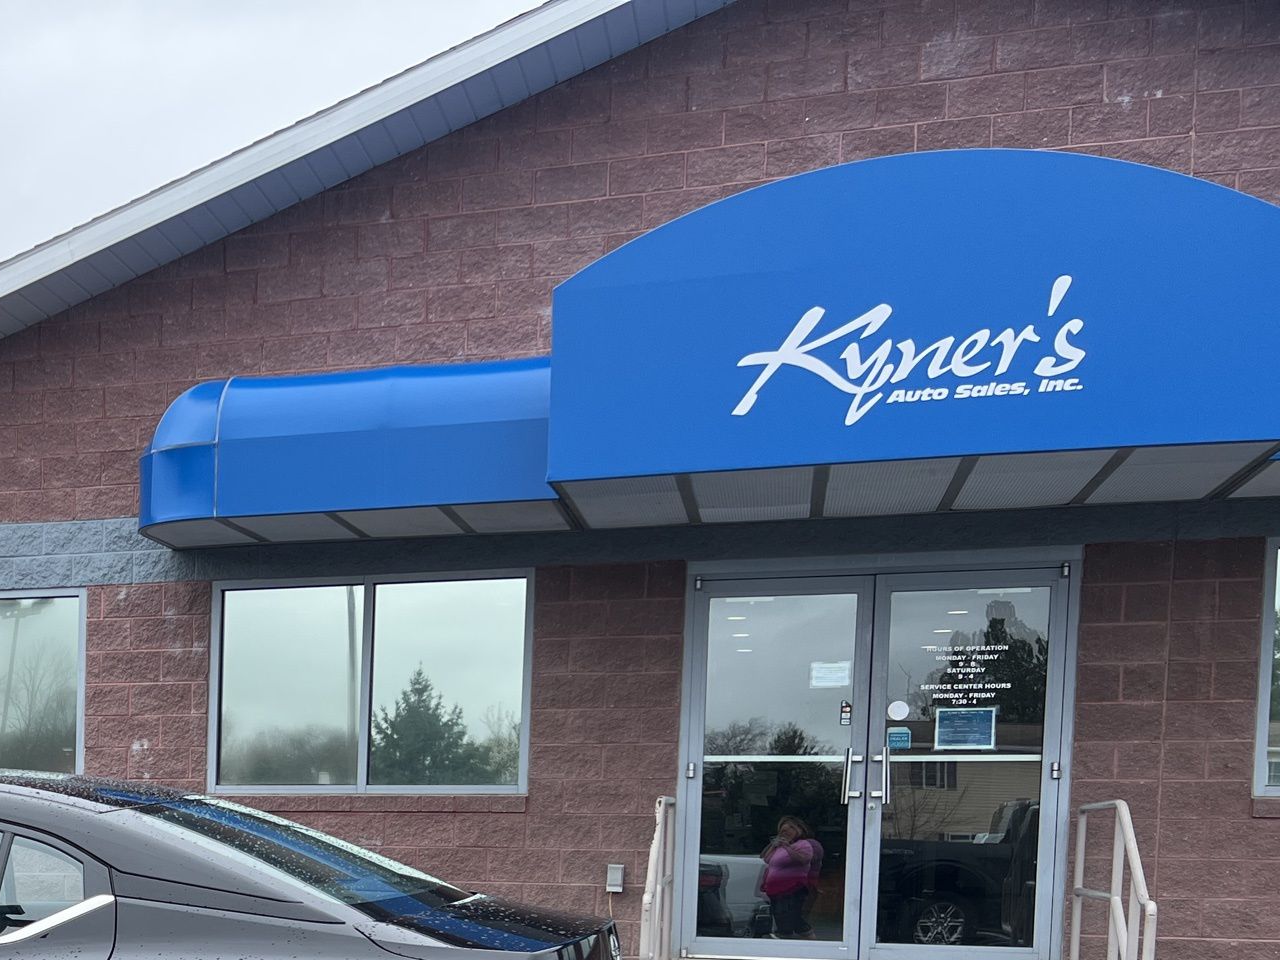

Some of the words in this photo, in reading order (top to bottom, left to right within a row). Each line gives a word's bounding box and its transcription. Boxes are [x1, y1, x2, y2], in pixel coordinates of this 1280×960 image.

[731, 275, 1086, 426] Kyner's
[886, 387, 949, 404] Auto
[954, 382, 1030, 400] Sales,
[1037, 376, 1084, 392] Inc.
